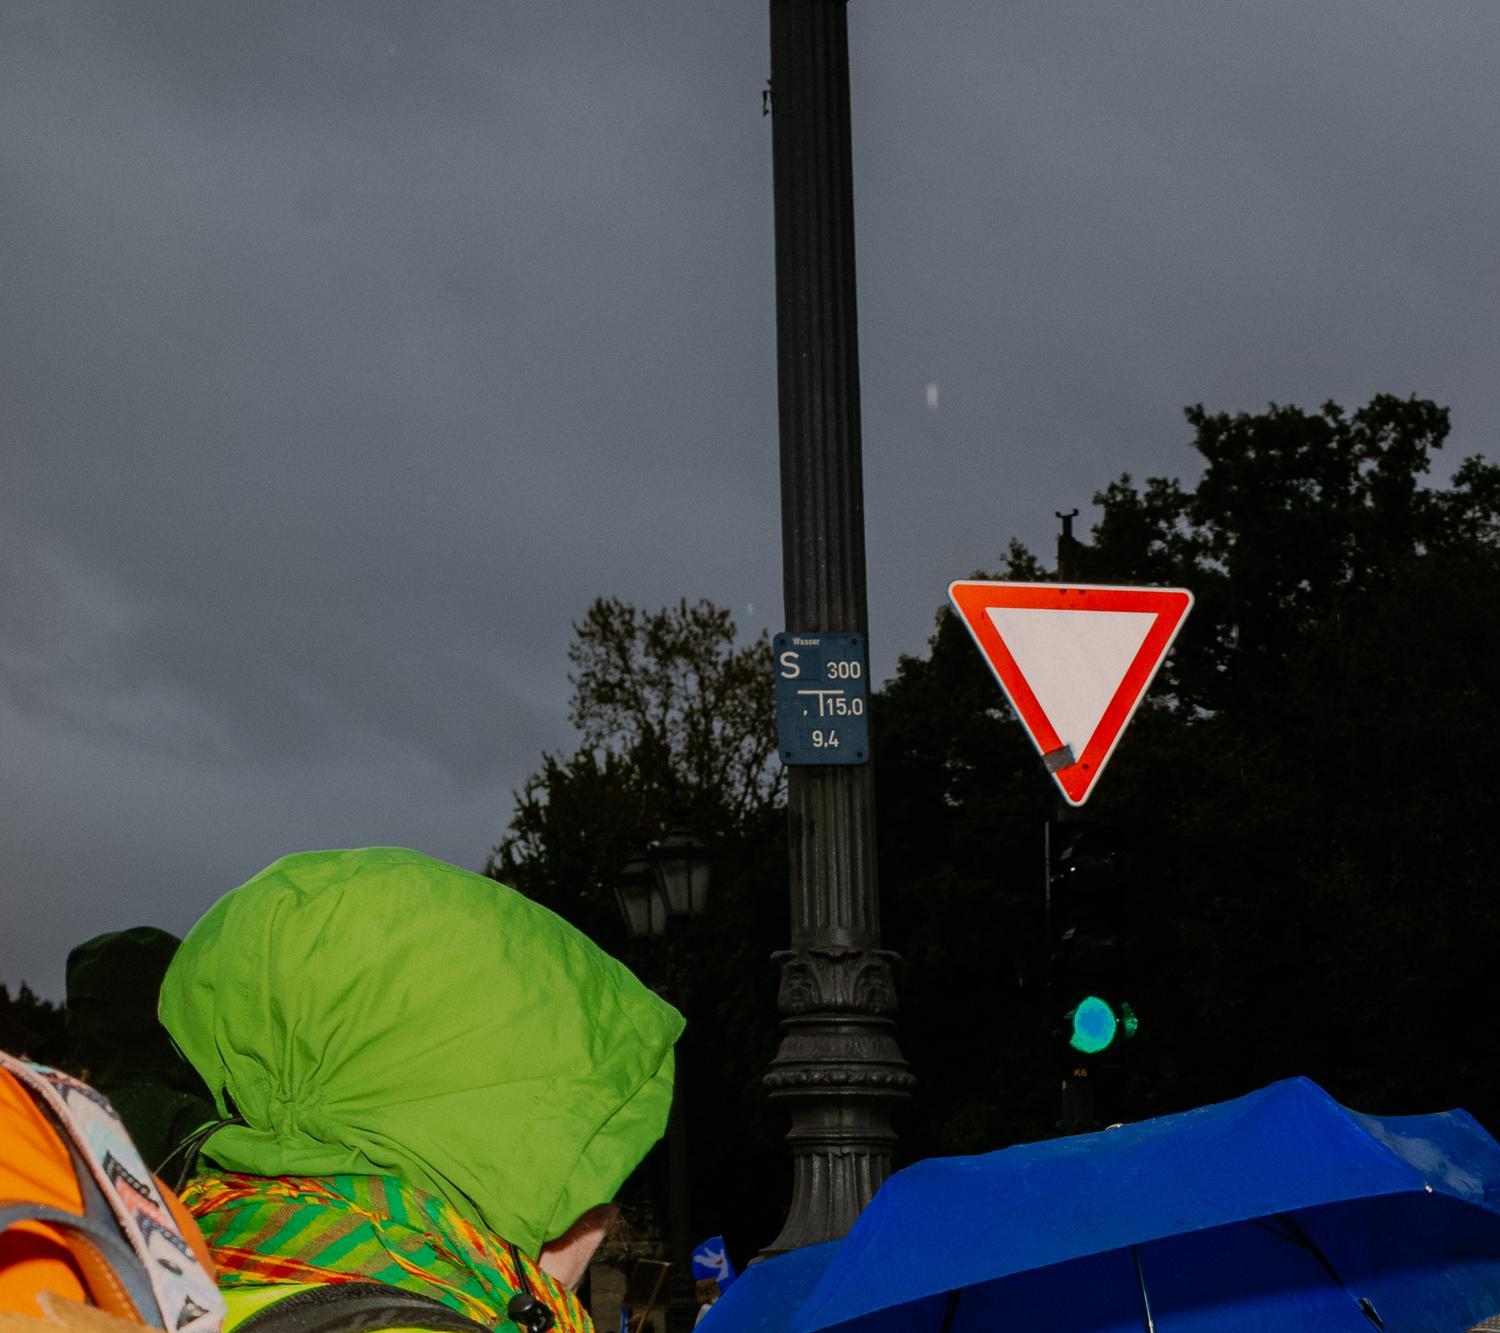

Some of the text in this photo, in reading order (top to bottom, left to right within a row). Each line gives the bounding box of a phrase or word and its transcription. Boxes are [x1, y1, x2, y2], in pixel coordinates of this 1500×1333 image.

[792, 637, 821, 646] Wasser
[779, 651, 861, 679] S 300
[826, 698, 864, 717] 15,0
[812, 730, 840, 749] 9,4
